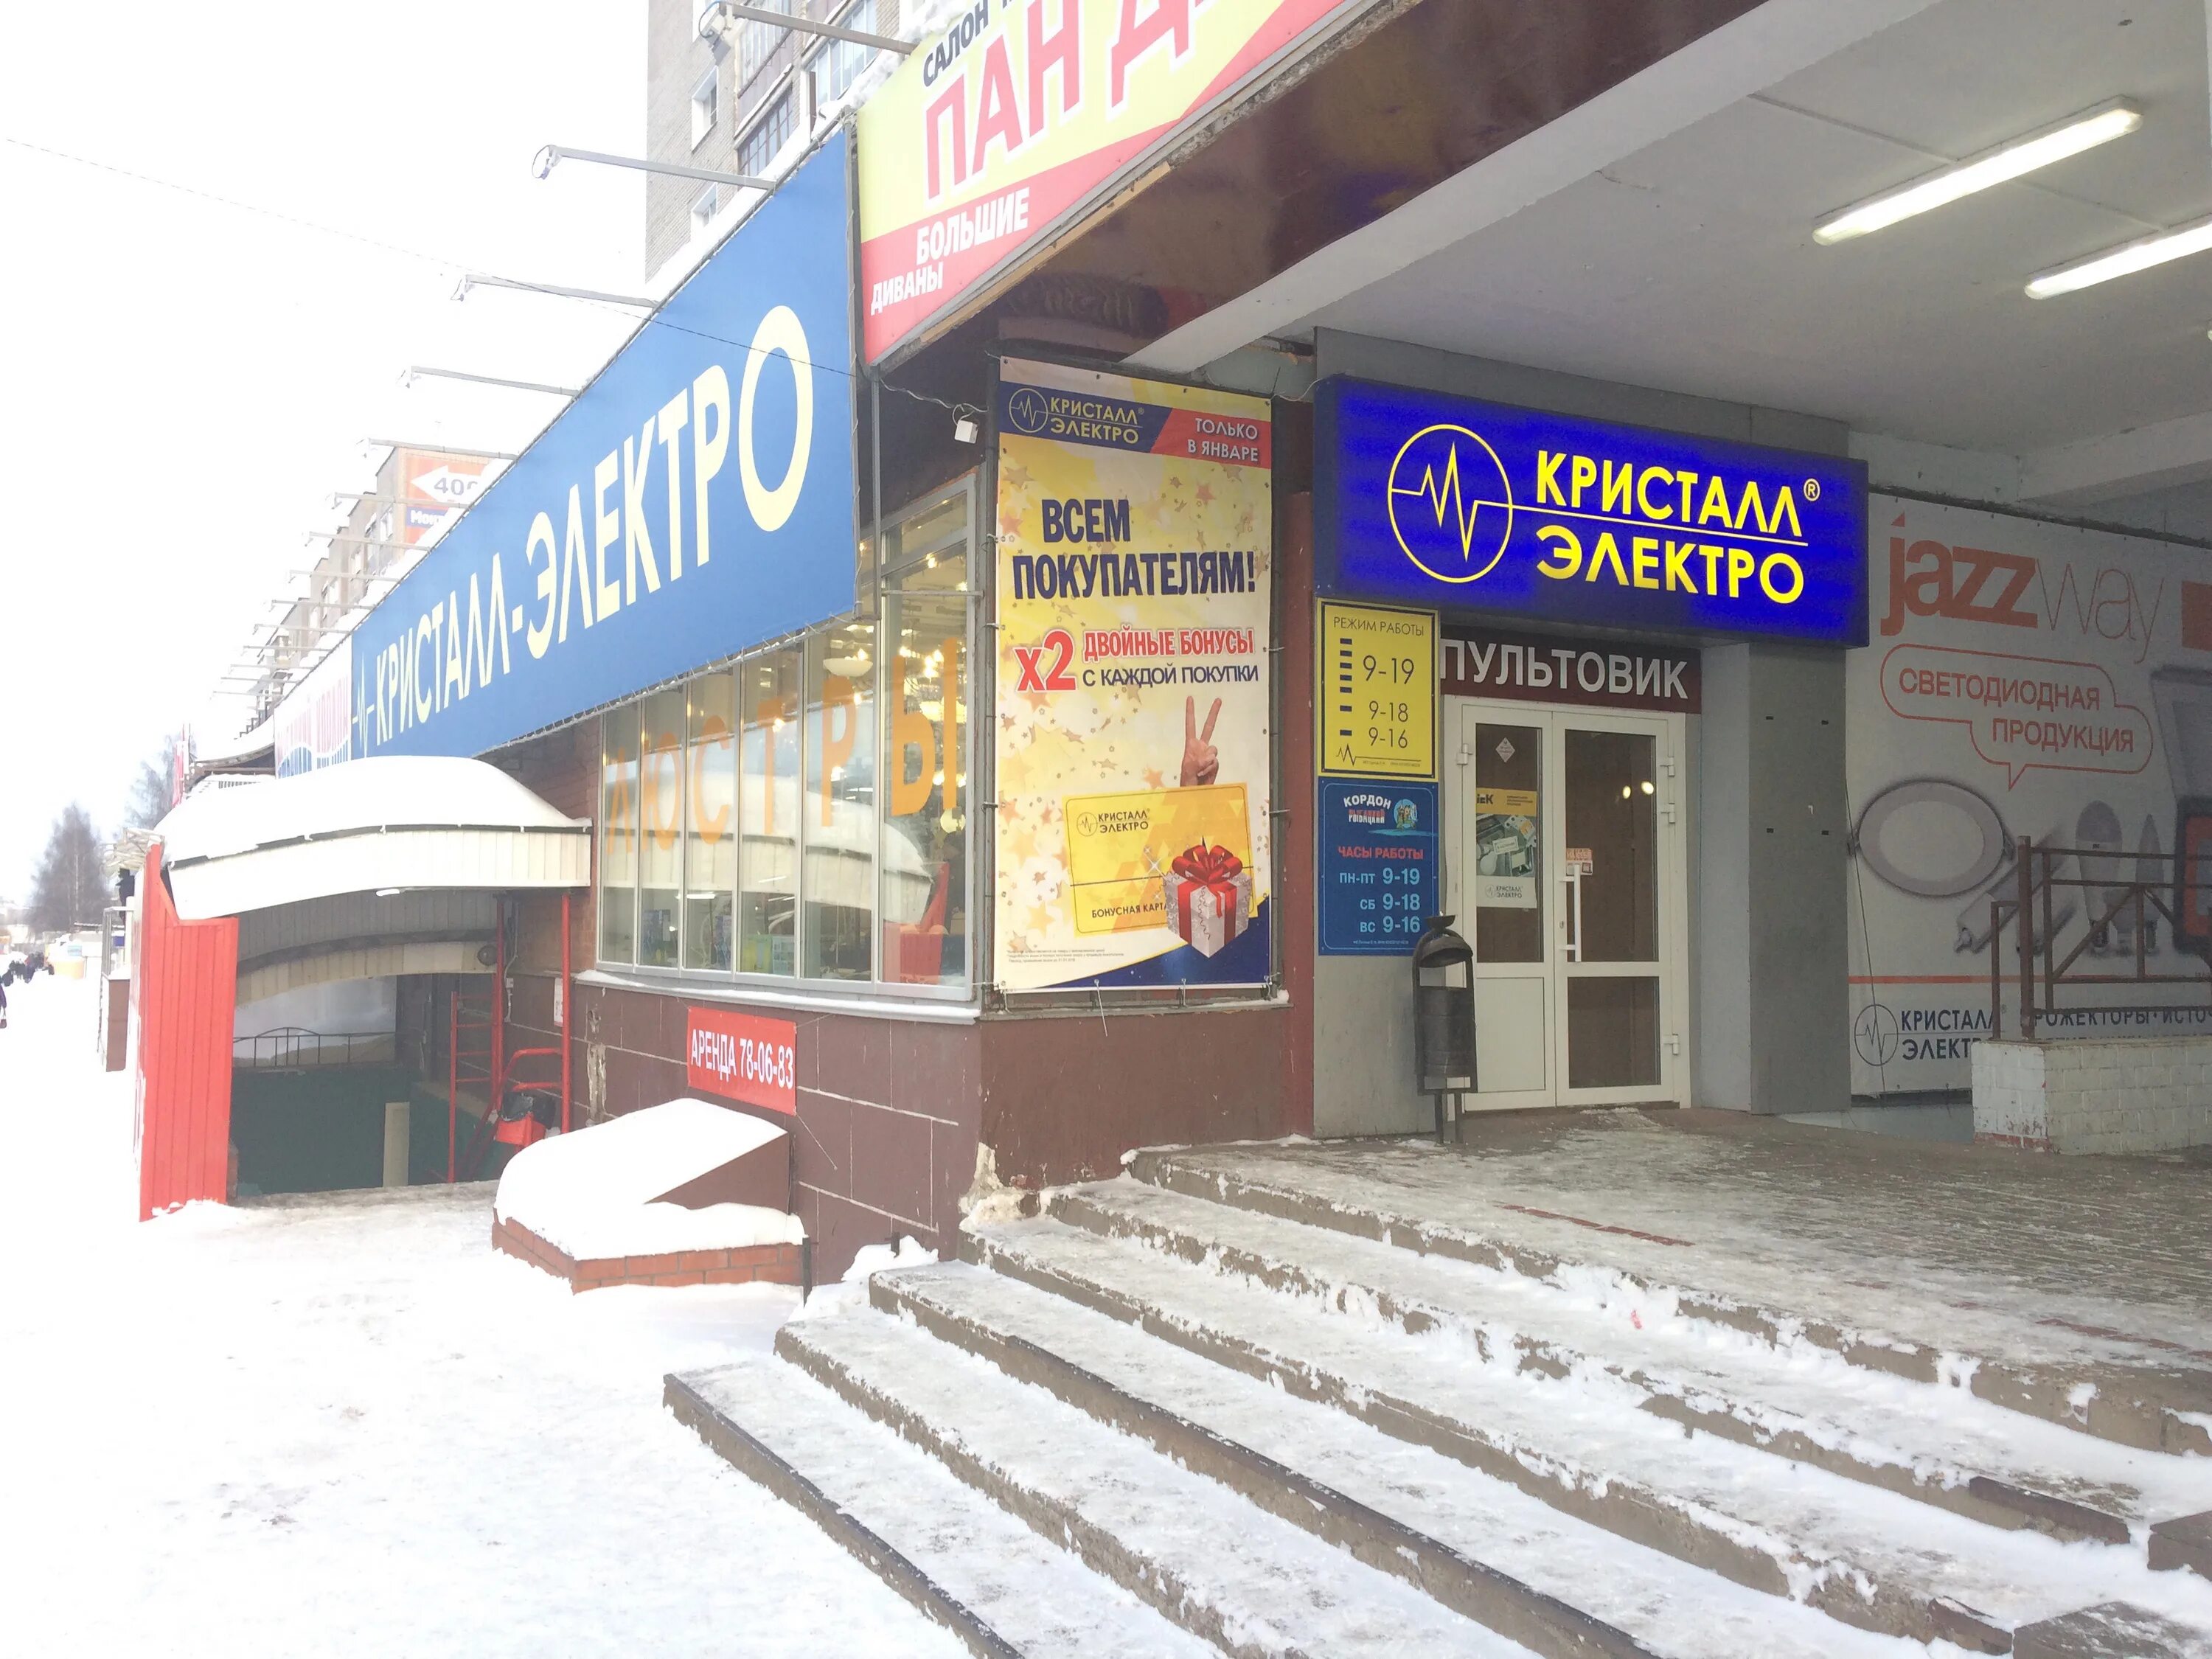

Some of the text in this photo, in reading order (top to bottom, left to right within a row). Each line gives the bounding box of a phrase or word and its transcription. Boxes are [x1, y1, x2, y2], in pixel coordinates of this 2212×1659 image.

[923, 0, 989, 86] САЛОН
[916, 187, 1029, 265] БОЛЬШИЕ
[871, 261, 943, 316] ДИВАНЫ
[1051, 417, 1139, 444] ЭЛЕКТРО
[1195, 417, 1259, 440] ТОЛЬКО
[1188, 439, 1259, 462] В ЯНВАРЕ
[1041, 498, 1130, 543] ВСЕМ
[1012, 551, 1256, 599] ПОКУПАТЕЛЯМ!
[1536, 524, 1804, 605] ЭЛЕКТРО
[1334, 616, 1424, 636] РЕЖИМ РАБОТЫ
[1085, 626, 1253, 661] ДВОЙНЫЕ БОНУСЫ
[1082, 663, 1259, 690] С КАЖДОЙ ПОКУПКИ
[1363, 655, 1414, 685] 9-19
[1441, 639, 1688, 700] ПУЛЬТОВИК
[1899, 667, 2101, 712] СВЕТОДИОДНАЯ
[1368, 700, 1409, 723] 9-18
[608, 637, 958, 854] ЛЮСТРЫ
[1368, 728, 1408, 749] 9-16
[1992, 718, 2135, 757] ПРОДУКЦИЯ
[1343, 794, 1391, 810] КОРДОН
[1099, 821, 1149, 834] ЭЛЕКТРО
[1338, 846, 1424, 860] ЧАСЫ РАБОТЫ
[1339, 867, 1420, 885] ПН-ПТ 9-19
[1092, 905, 1141, 918] БОНУСНАЯ
[1360, 893, 1420, 911] СБ 9-18
[1360, 916, 1421, 933] ВС 9-16
[2162, 1008, 2212, 1024] ИСТО
[691, 1029, 794, 1091] АРЕНДА 78-06-83
